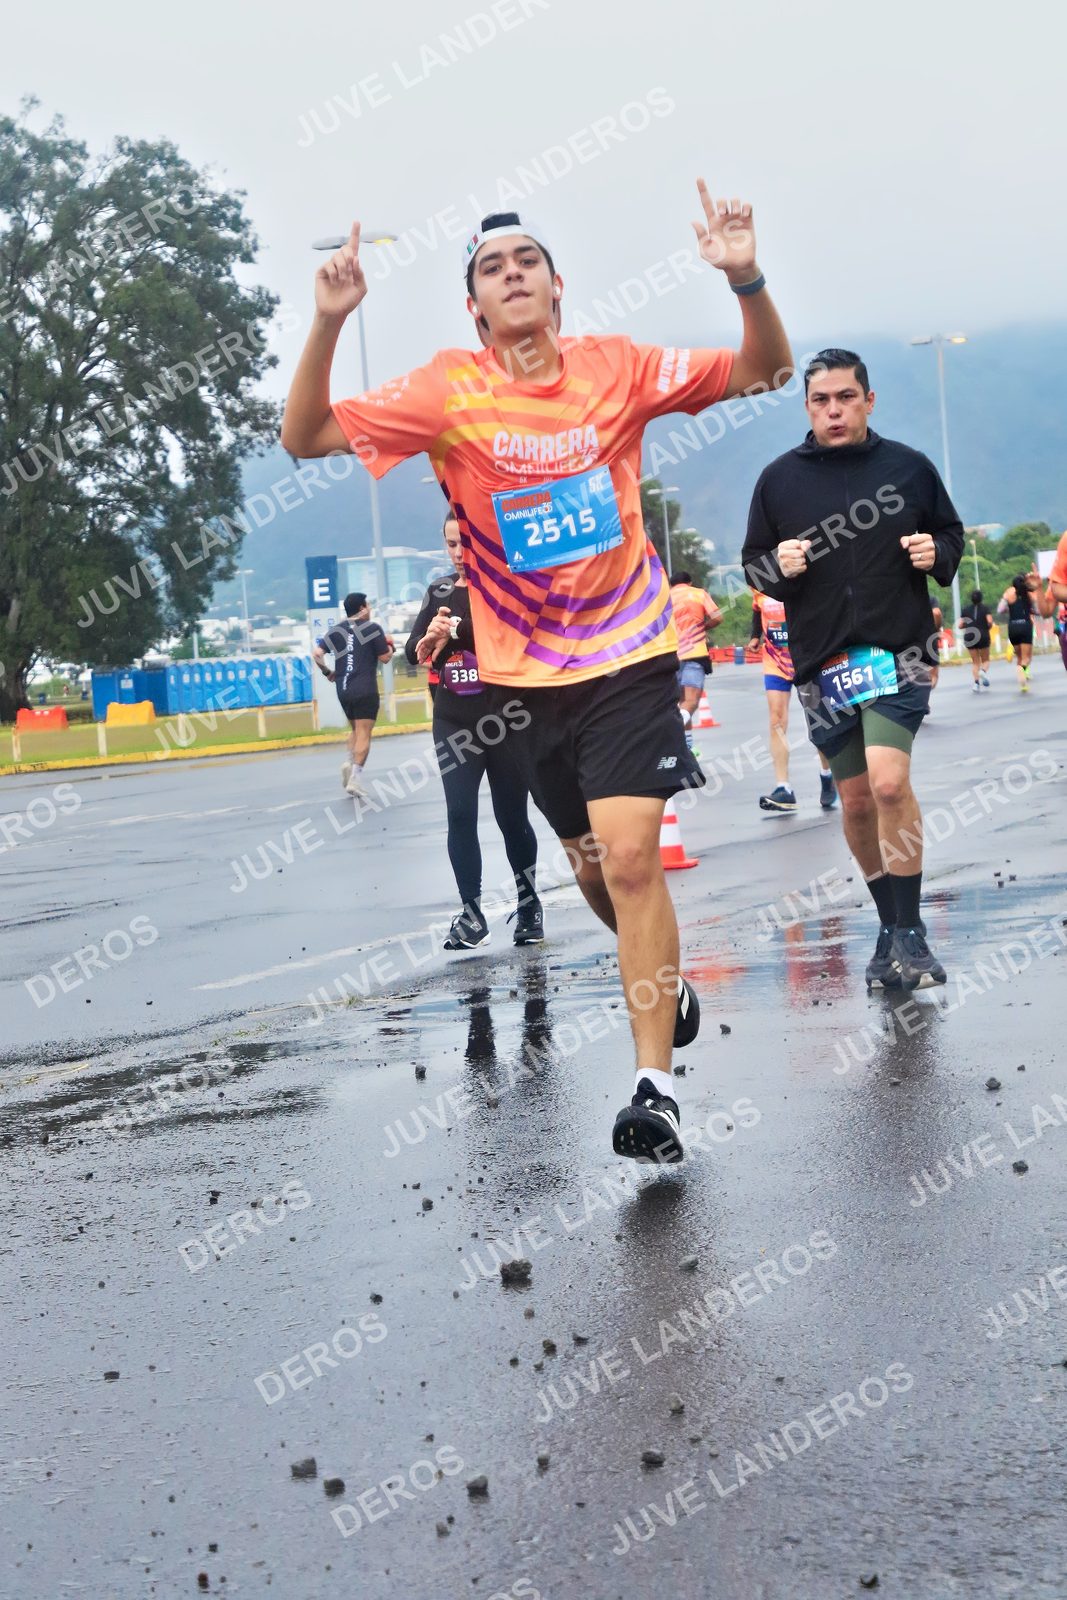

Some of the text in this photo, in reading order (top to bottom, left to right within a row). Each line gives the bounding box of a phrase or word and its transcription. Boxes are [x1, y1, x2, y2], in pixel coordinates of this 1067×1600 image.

[493, 424, 599, 462] CARRERA
[524, 508, 597, 547] 2515
[312, 578, 331, 602] E
[451, 669, 478, 683] 338
[832, 665, 874, 692] 1561
